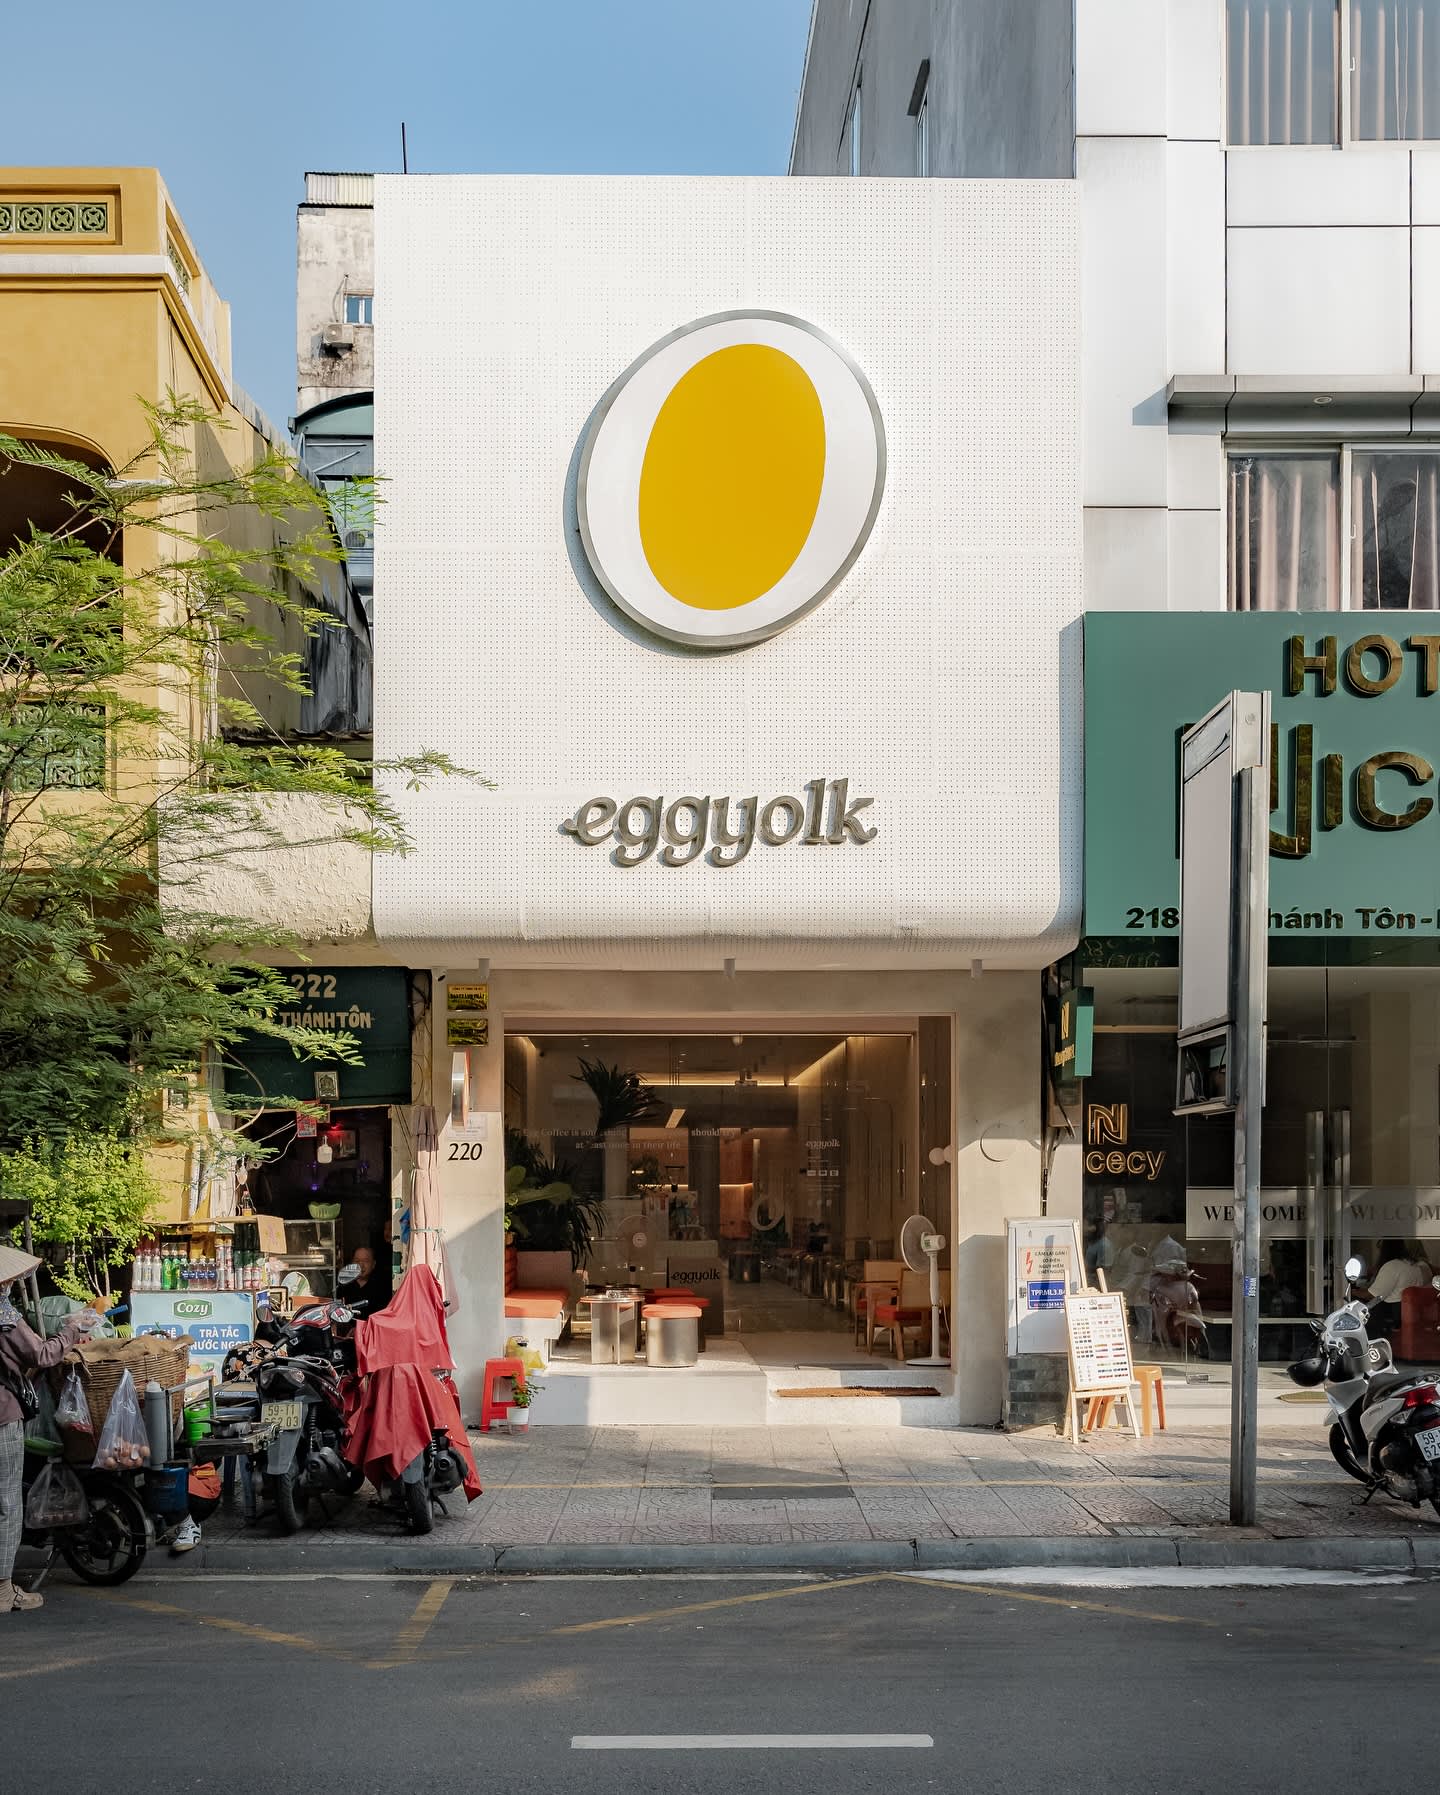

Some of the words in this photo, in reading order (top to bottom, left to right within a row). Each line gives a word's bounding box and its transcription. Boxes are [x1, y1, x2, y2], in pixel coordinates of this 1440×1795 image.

[1290, 634, 1440, 694] HOT
[562, 777, 878, 867] eggyolk
[1125, 907, 1179, 928] 218
[1267, 906, 1344, 929] hánh
[291, 973, 337, 998] 222
[691, 1127, 721, 1138] should
[447, 1142, 483, 1161] 220
[1083, 1150, 1165, 1180] cecy
[1203, 1205, 1309, 1222] WEOME
[670, 1268, 721, 1285] eggyolk
[176, 1302, 209, 1316] Cozy
[199, 1325, 219, 1338] TRÀ
